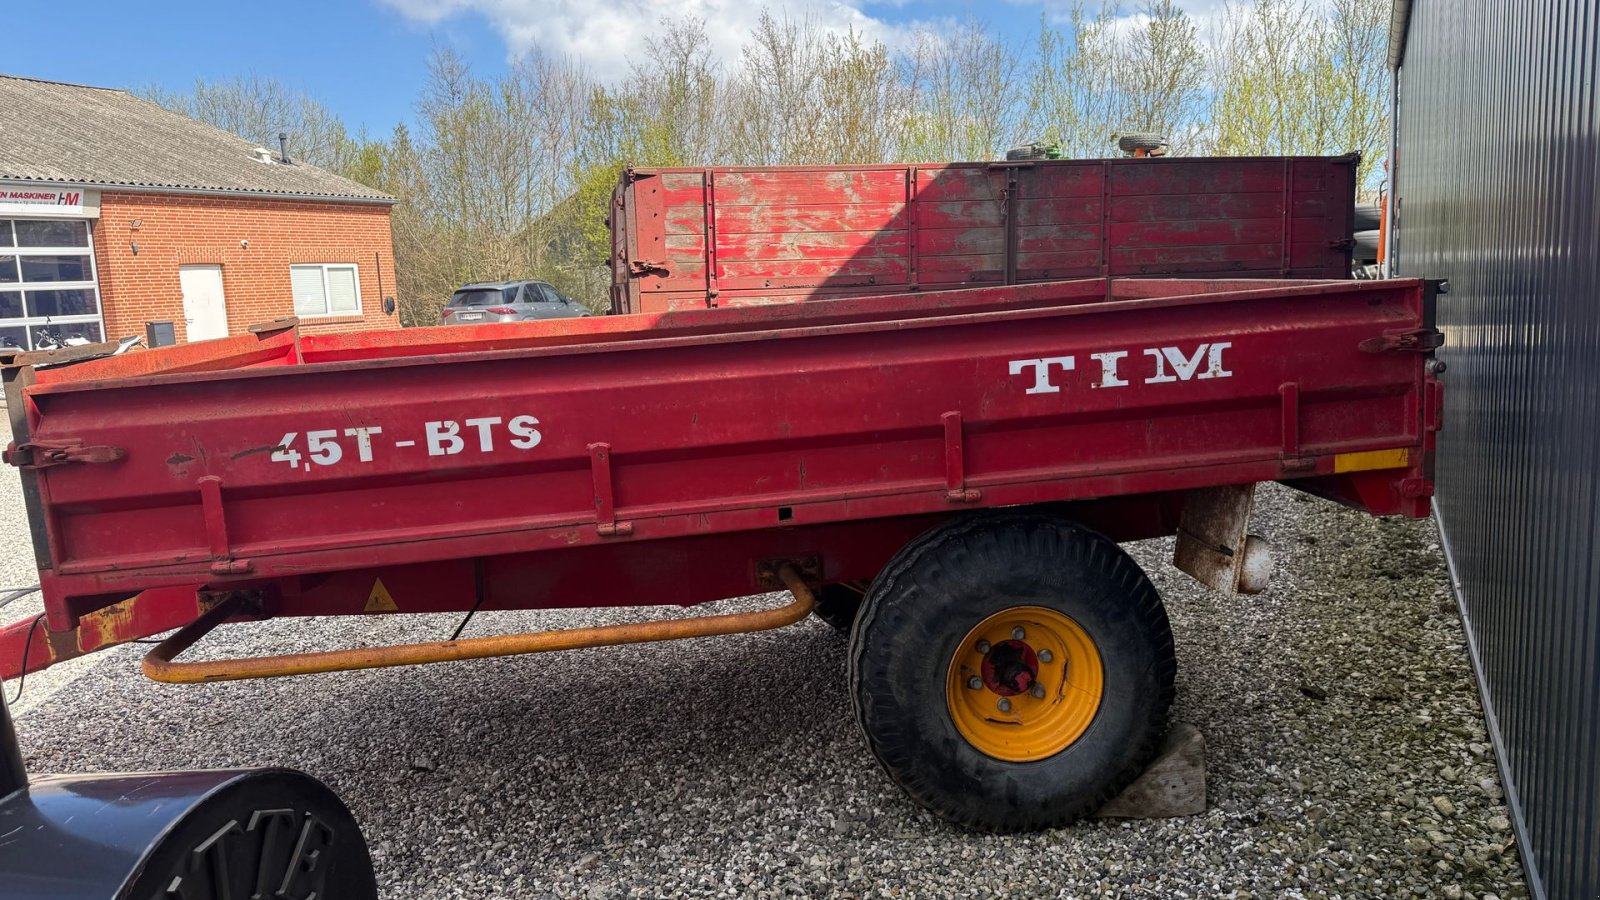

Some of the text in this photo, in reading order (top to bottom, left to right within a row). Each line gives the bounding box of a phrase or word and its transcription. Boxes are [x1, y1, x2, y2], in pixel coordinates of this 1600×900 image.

[9, 192, 56, 200] MASKINER
[1008, 341, 1233, 395] TIM
[270, 425, 383, 472] 4,5T
[424, 414, 542, 457] BTS
